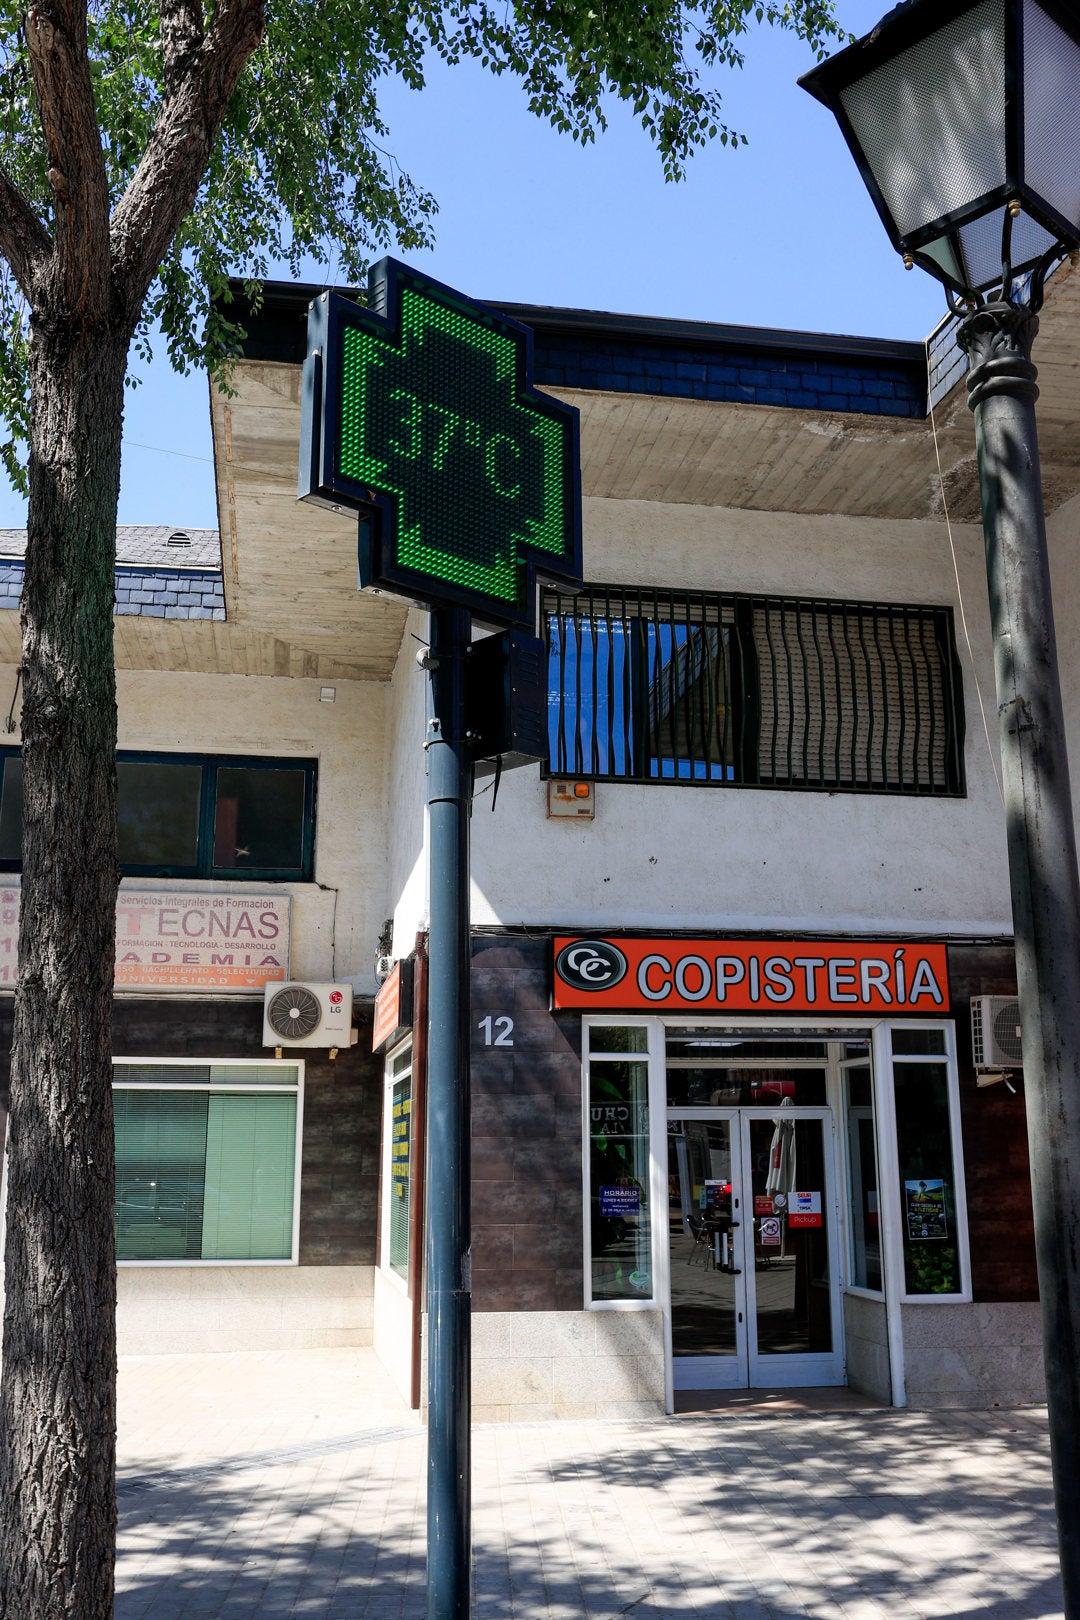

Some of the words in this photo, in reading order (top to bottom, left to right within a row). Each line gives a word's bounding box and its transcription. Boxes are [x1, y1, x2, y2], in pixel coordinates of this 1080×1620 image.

[120, 895, 163, 905] Servicios
[165, 896, 210, 908] Integrales
[213, 898, 224, 908] de
[115, 907, 280, 940] TECNAS
[225, 942, 276, 951] DESARROLLO
[120, 952, 281, 967] ADEMIA
[142, 966, 209, 974] BACHILLERATO
[217, 967, 280, 976] SELECTIVIDAD
[636, 948, 943, 1004] COPISTERÍA
[117, 975, 228, 984] UNIVERSIDAD
[330, 1006, 342, 1014] LG
[478, 1016, 515, 1046] 12
